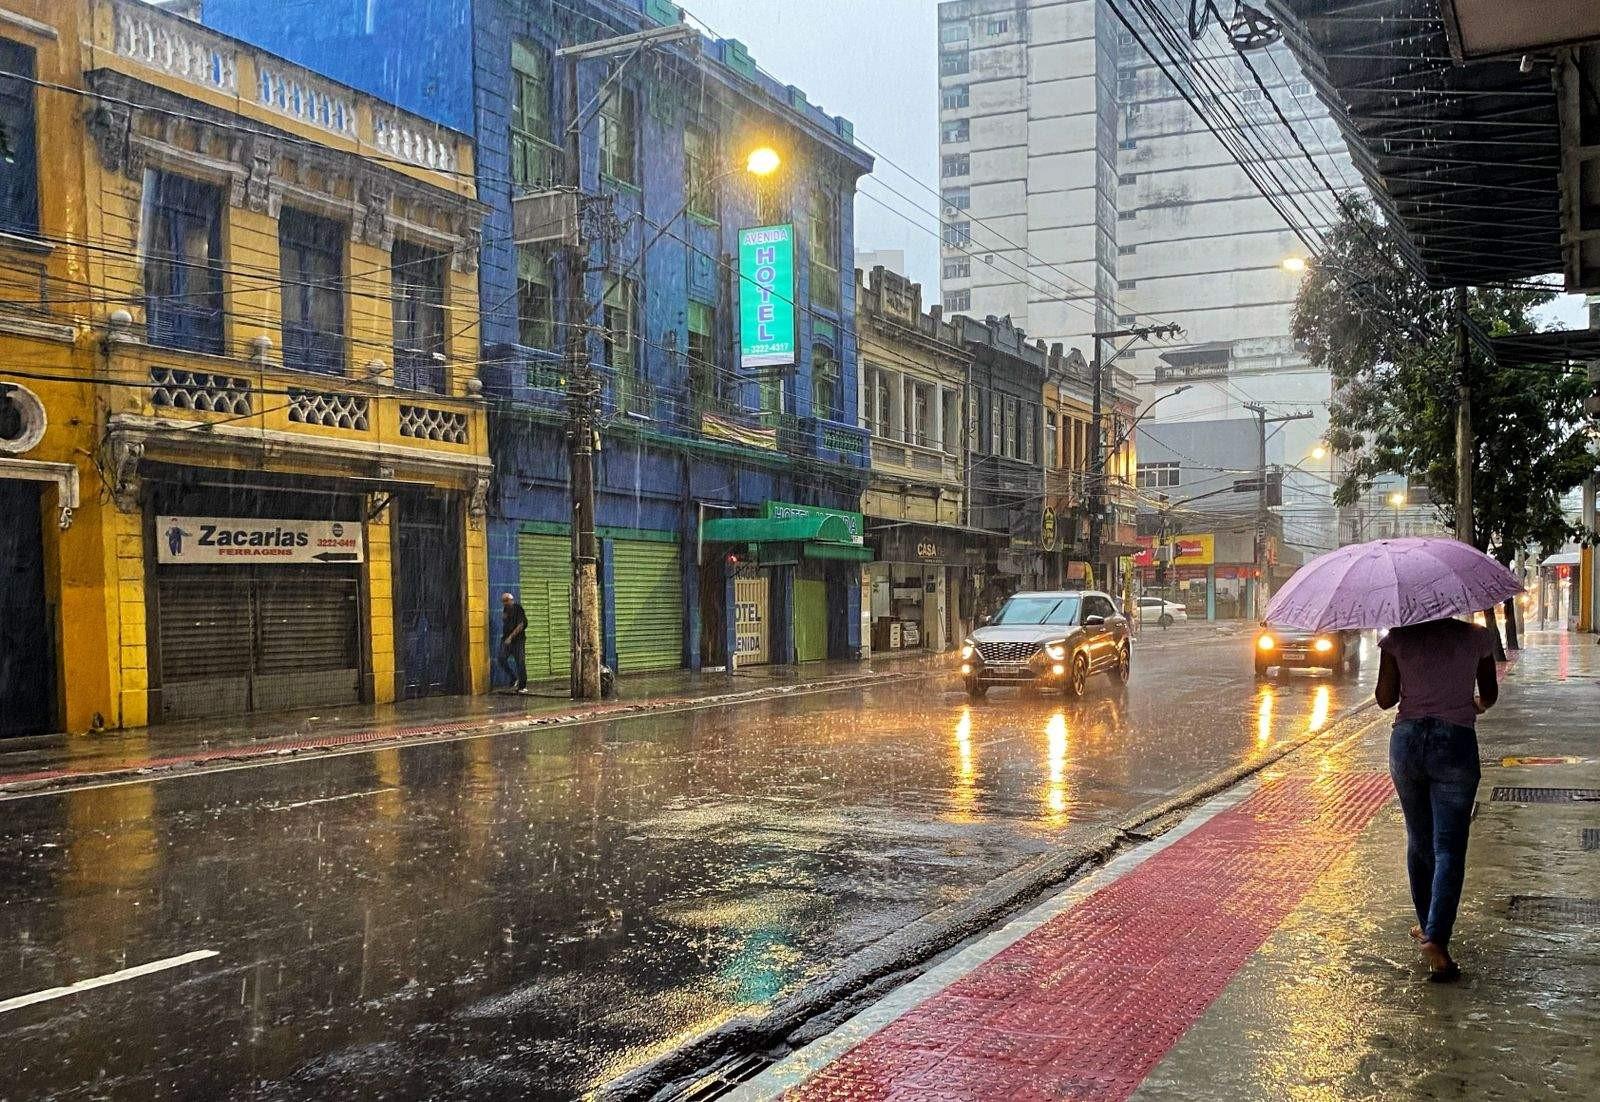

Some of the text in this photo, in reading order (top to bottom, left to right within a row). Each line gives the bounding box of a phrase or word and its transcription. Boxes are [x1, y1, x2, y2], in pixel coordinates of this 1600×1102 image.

[744, 228, 788, 245] AVENIDA
[756, 245, 775, 341] HOTEL
[198, 524, 308, 547] Zacarias
[219, 548, 293, 556] FERRAGENS
[917, 543, 937, 557] CASA
